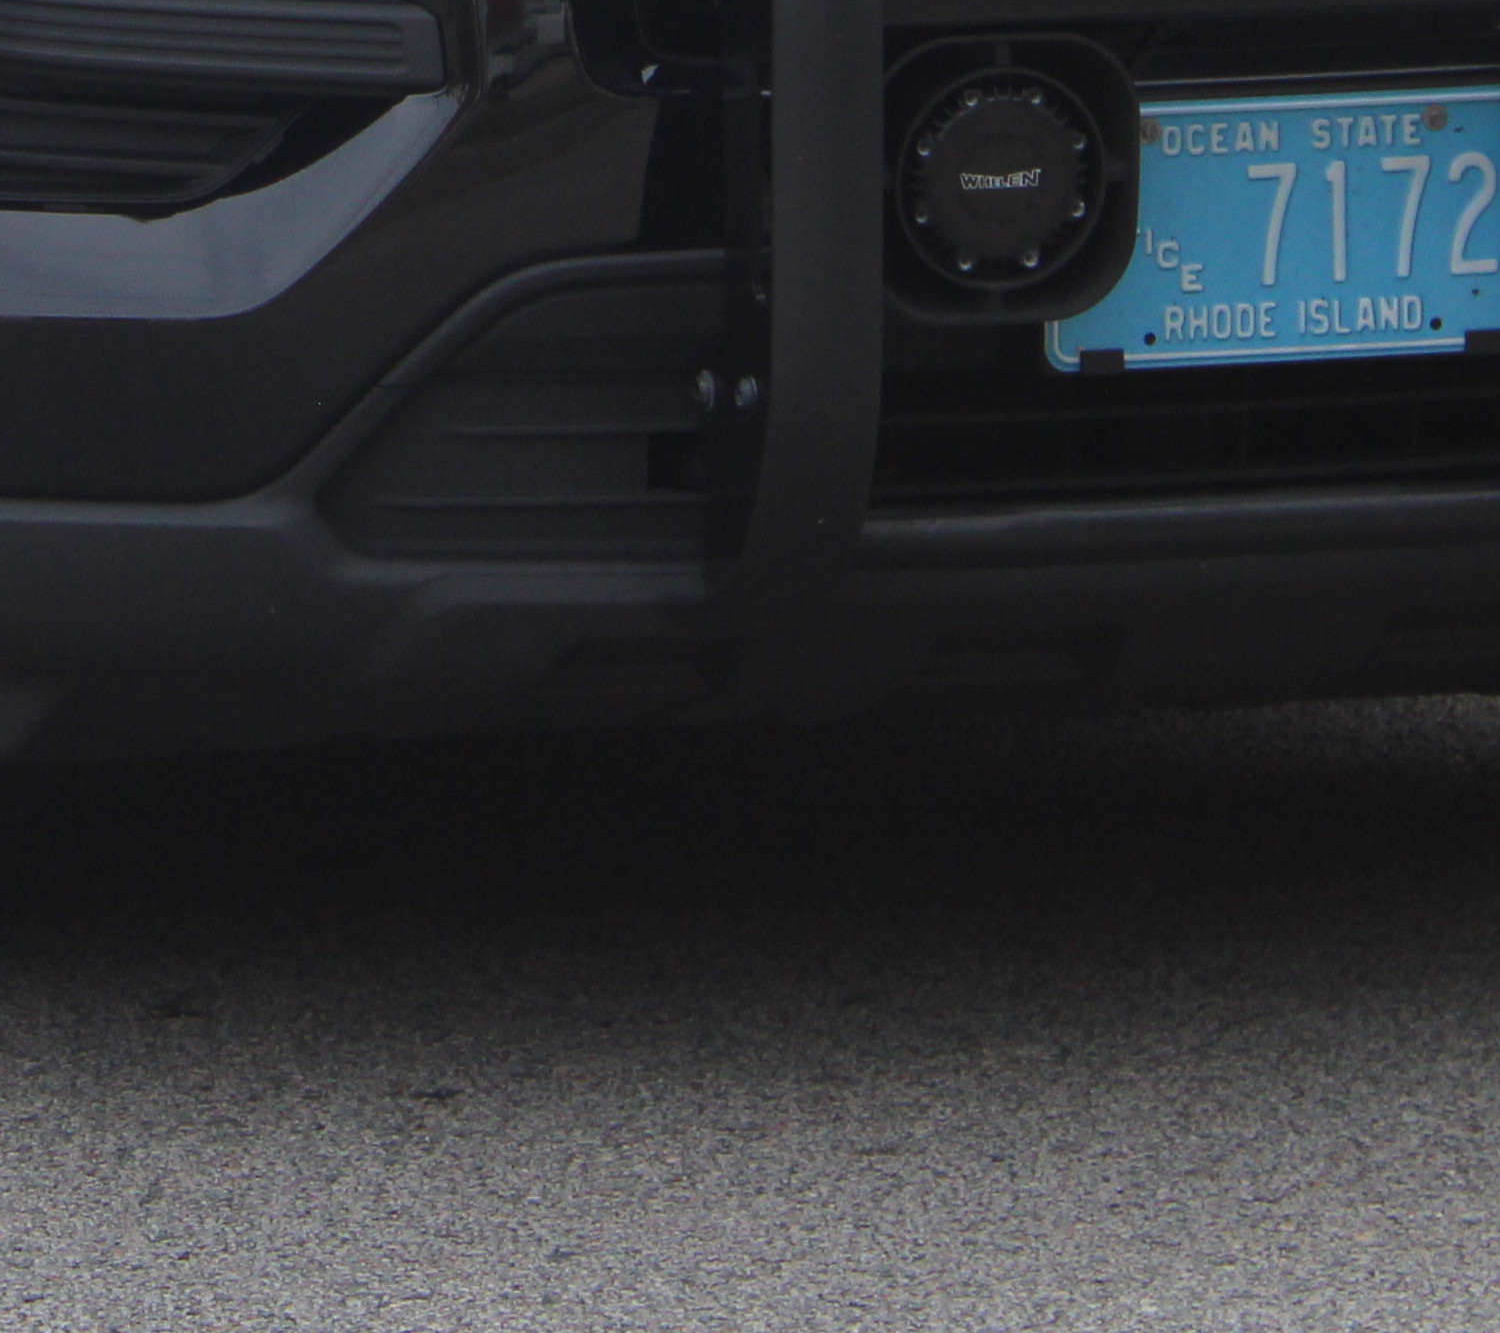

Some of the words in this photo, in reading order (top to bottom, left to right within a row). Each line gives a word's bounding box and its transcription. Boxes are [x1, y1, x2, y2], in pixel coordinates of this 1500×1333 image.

[1161, 120, 1280, 156] OCEAN
[1310, 113, 1422, 150] STATE
[960, 168, 1041, 190] WHELEN
[1247, 151, 1500, 286] 7172
[1137, 227, 1204, 293] ICE
[1163, 300, 1278, 342] RHODE
[1298, 294, 1424, 335] ISLAND
